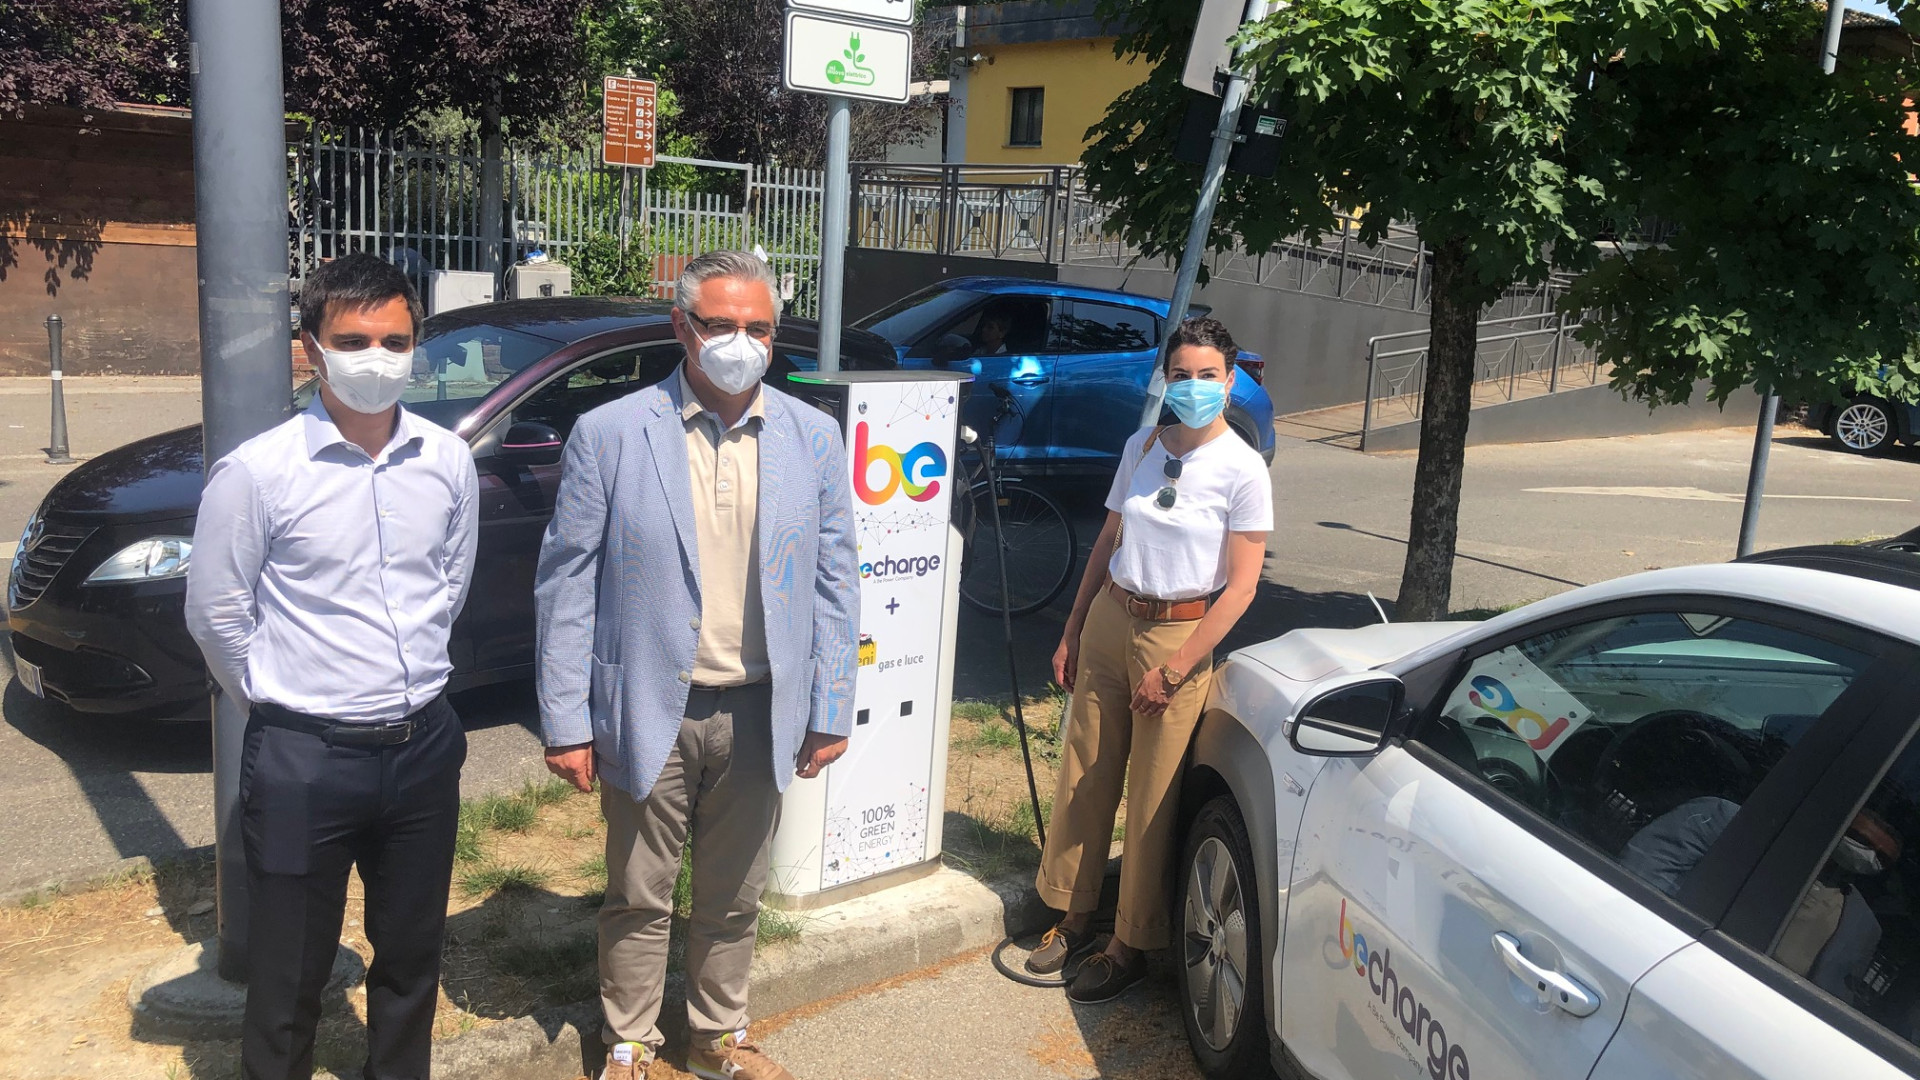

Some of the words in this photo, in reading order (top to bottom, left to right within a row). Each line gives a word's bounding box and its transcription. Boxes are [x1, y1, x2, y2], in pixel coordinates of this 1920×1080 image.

[853, 421, 947, 505] be
[859, 554, 940, 578] echarge
[878, 659, 895, 672] gas
[896, 658, 903, 667] e
[904, 654, 924, 666] luce
[861, 803, 896, 824] 100%
[860, 821, 895, 839] GREEN
[858, 835, 895, 852] ENERGY
[1339, 898, 1470, 1080] becharge
